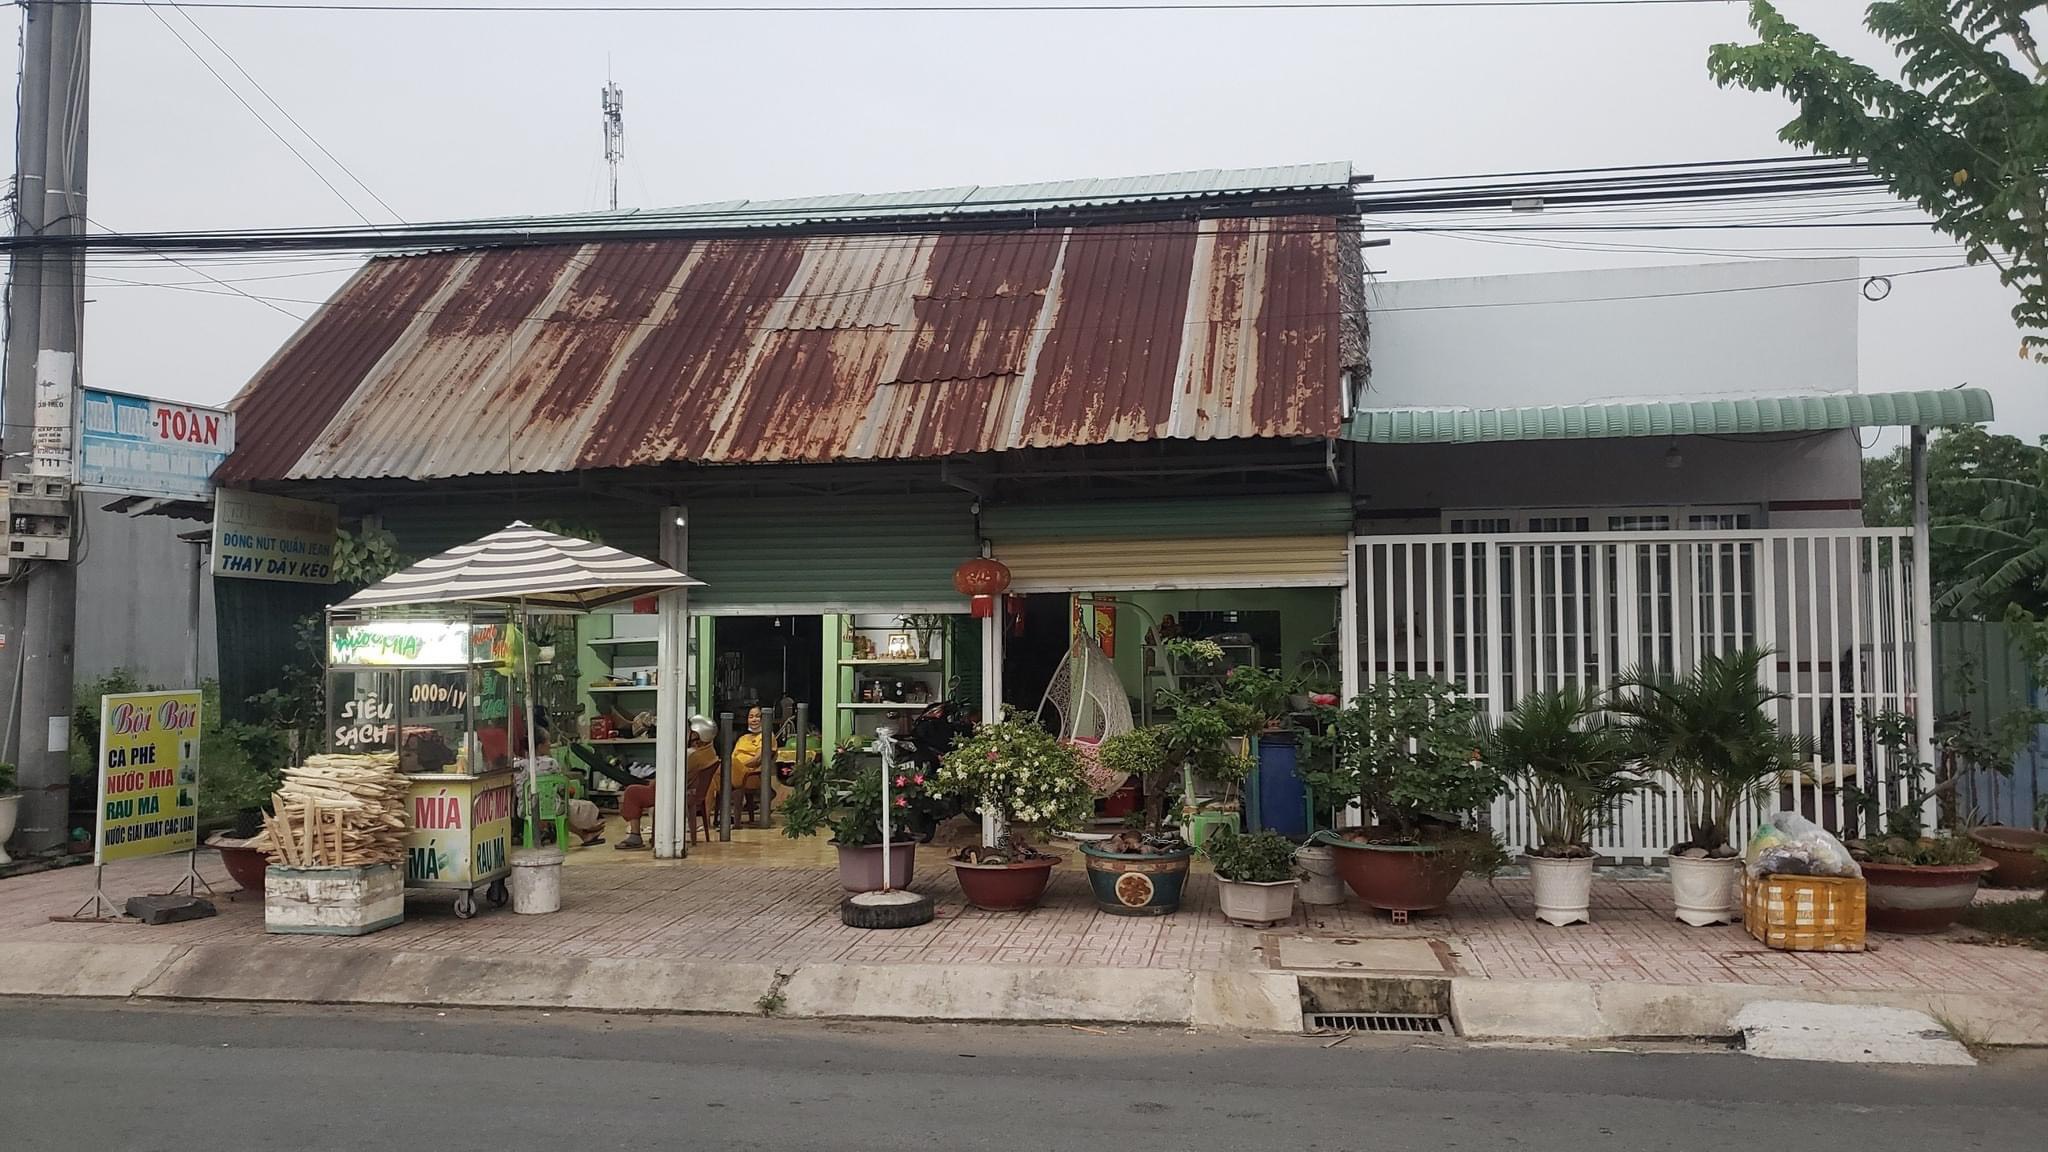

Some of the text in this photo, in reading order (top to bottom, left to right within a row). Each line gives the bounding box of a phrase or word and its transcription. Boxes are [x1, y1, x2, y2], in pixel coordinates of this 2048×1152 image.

[222, 555, 329, 578] THAY DÂY KÉO
[341, 692, 394, 719] SIÊU
[335, 724, 389, 750] SẠCH
[108, 742, 156, 769] CÀ PHÊ
[107, 766, 174, 795] NƯỚC MÍA
[106, 792, 160, 821] RAU MÁ
[415, 788, 462, 830] MÍA
[104, 825, 126, 847] NƯỚC
[408, 838, 439, 880] MÁ
[476, 827, 506, 876] RAU MÁ
